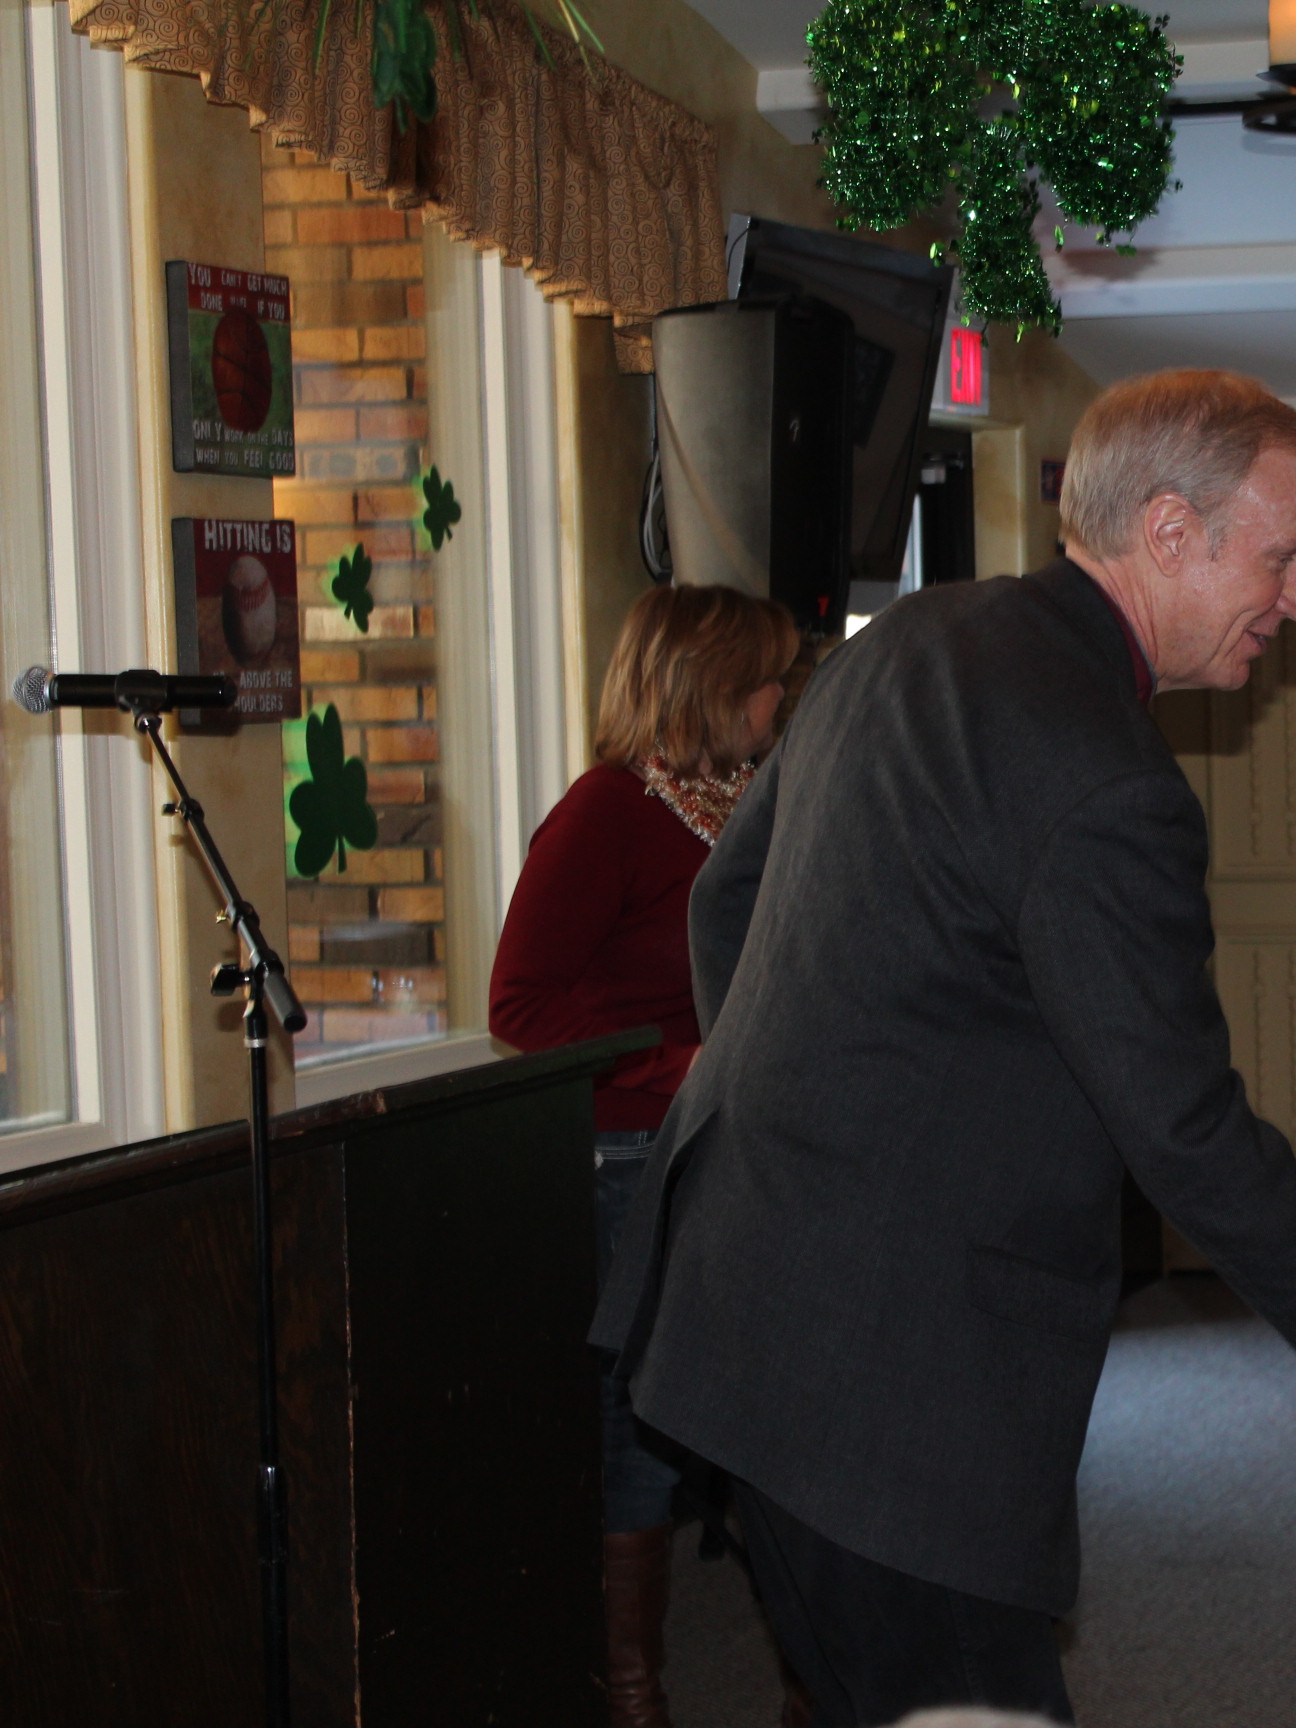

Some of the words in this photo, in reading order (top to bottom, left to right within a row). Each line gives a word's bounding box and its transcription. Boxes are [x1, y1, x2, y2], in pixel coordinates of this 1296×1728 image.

[188, 263, 211, 288] YOU
[247, 274, 261, 292] GET
[263, 277, 287, 296] MUCH
[200, 290, 223, 312] DONE
[257, 299, 264, 317] IF
[268, 301, 285, 320] YOU
[193, 419, 222, 442] ONLY
[223, 428, 244, 443] WORK
[271, 428, 293, 446] DAYS
[195, 447, 220, 464] WHEN
[224, 451, 239, 465] YOU
[243, 449, 263, 468] FEEL
[269, 451, 294, 471] GOOD
[204, 519, 272, 554] HITTING
[275, 523, 291, 554] IS
[239, 670, 272, 688] ABOVE
[274, 670, 293, 688] THE
[233, 693, 284, 713] HOULDERS
